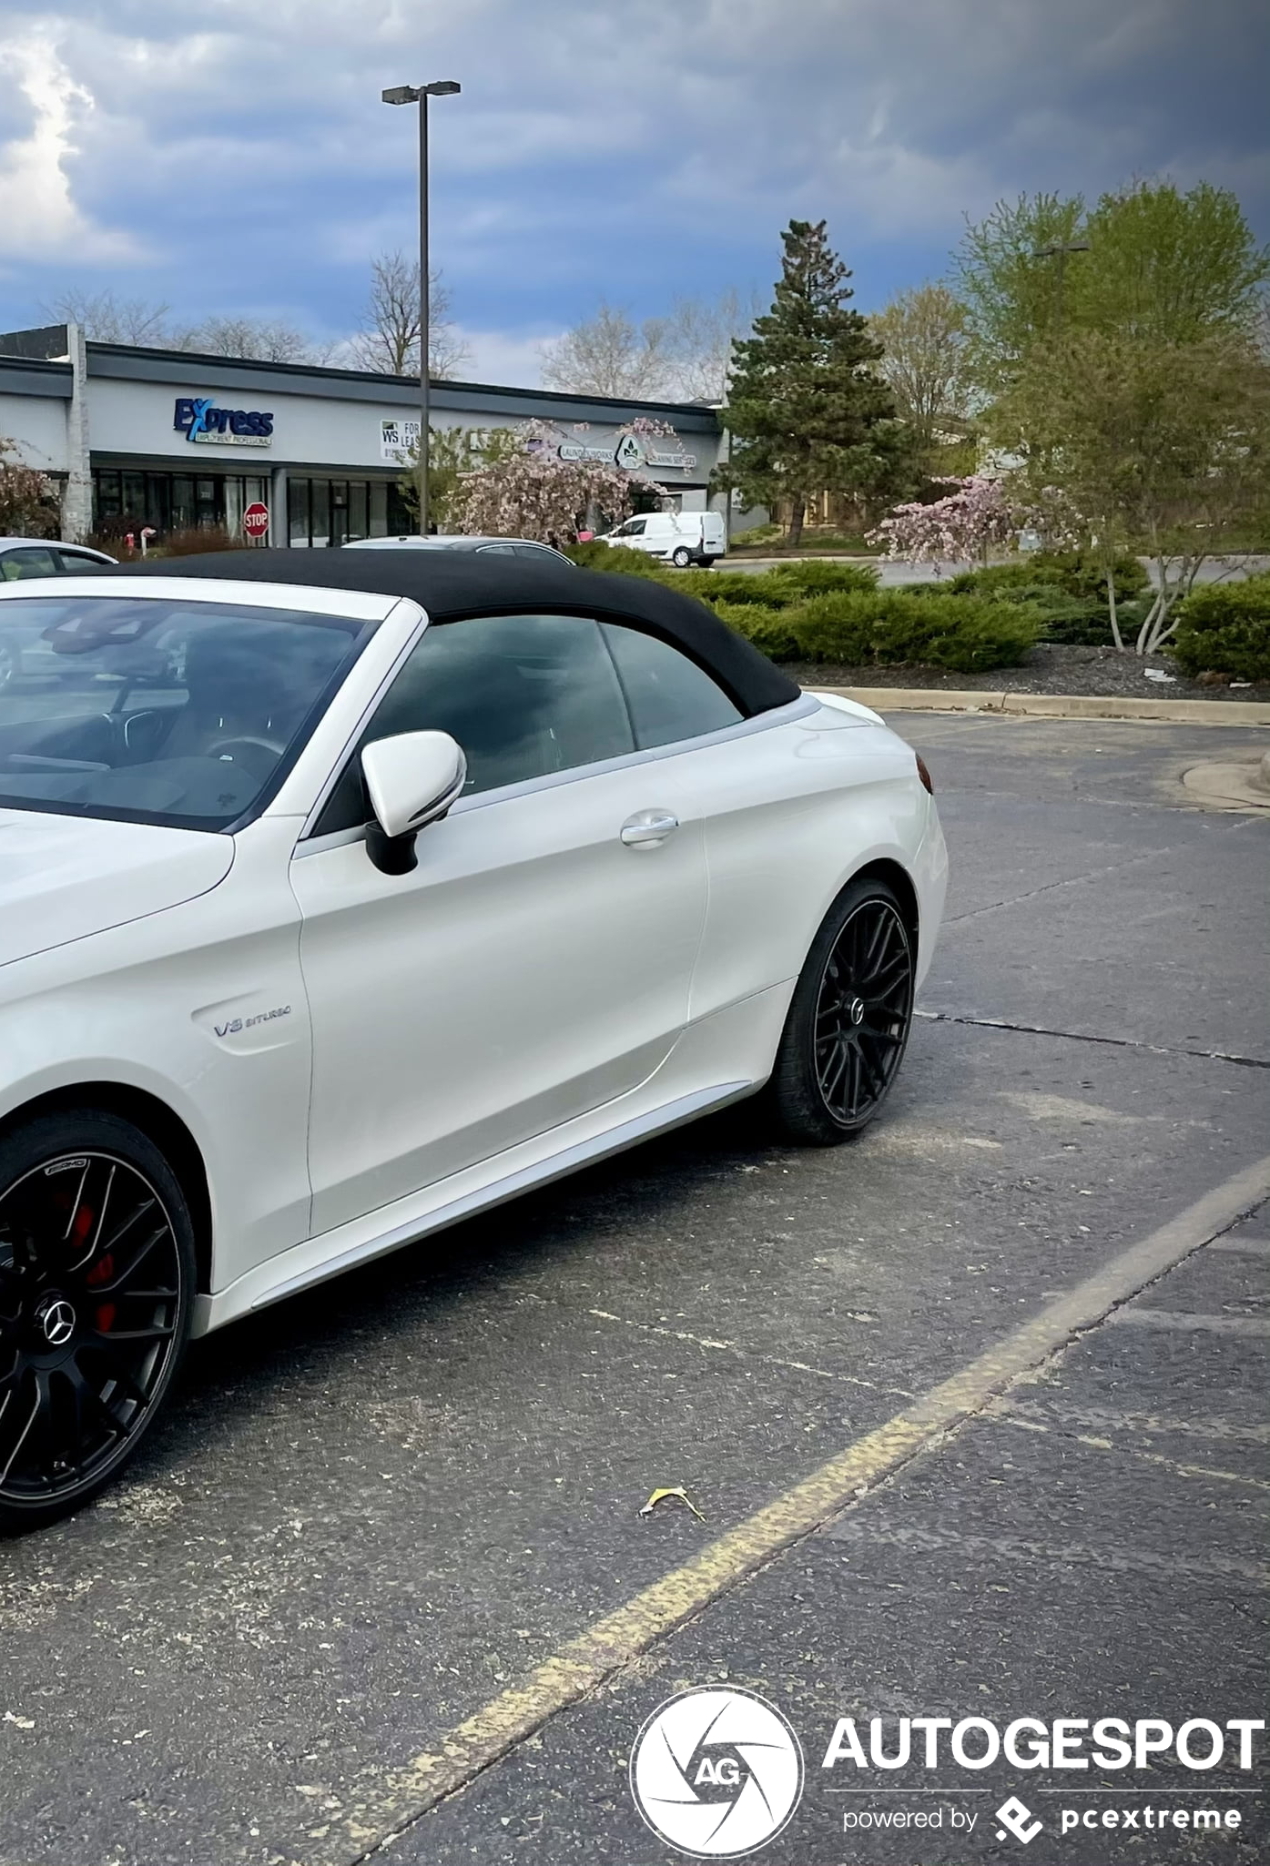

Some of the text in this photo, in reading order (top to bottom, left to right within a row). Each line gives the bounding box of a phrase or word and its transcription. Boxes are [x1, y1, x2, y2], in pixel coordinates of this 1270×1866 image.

[405, 423, 420, 435] FOR
[382, 431, 399, 443] WS
[401, 436, 420, 448] LEAS
[246, 513, 267, 527] STOP
[214, 1006, 291, 1037] V8 BITURBO
